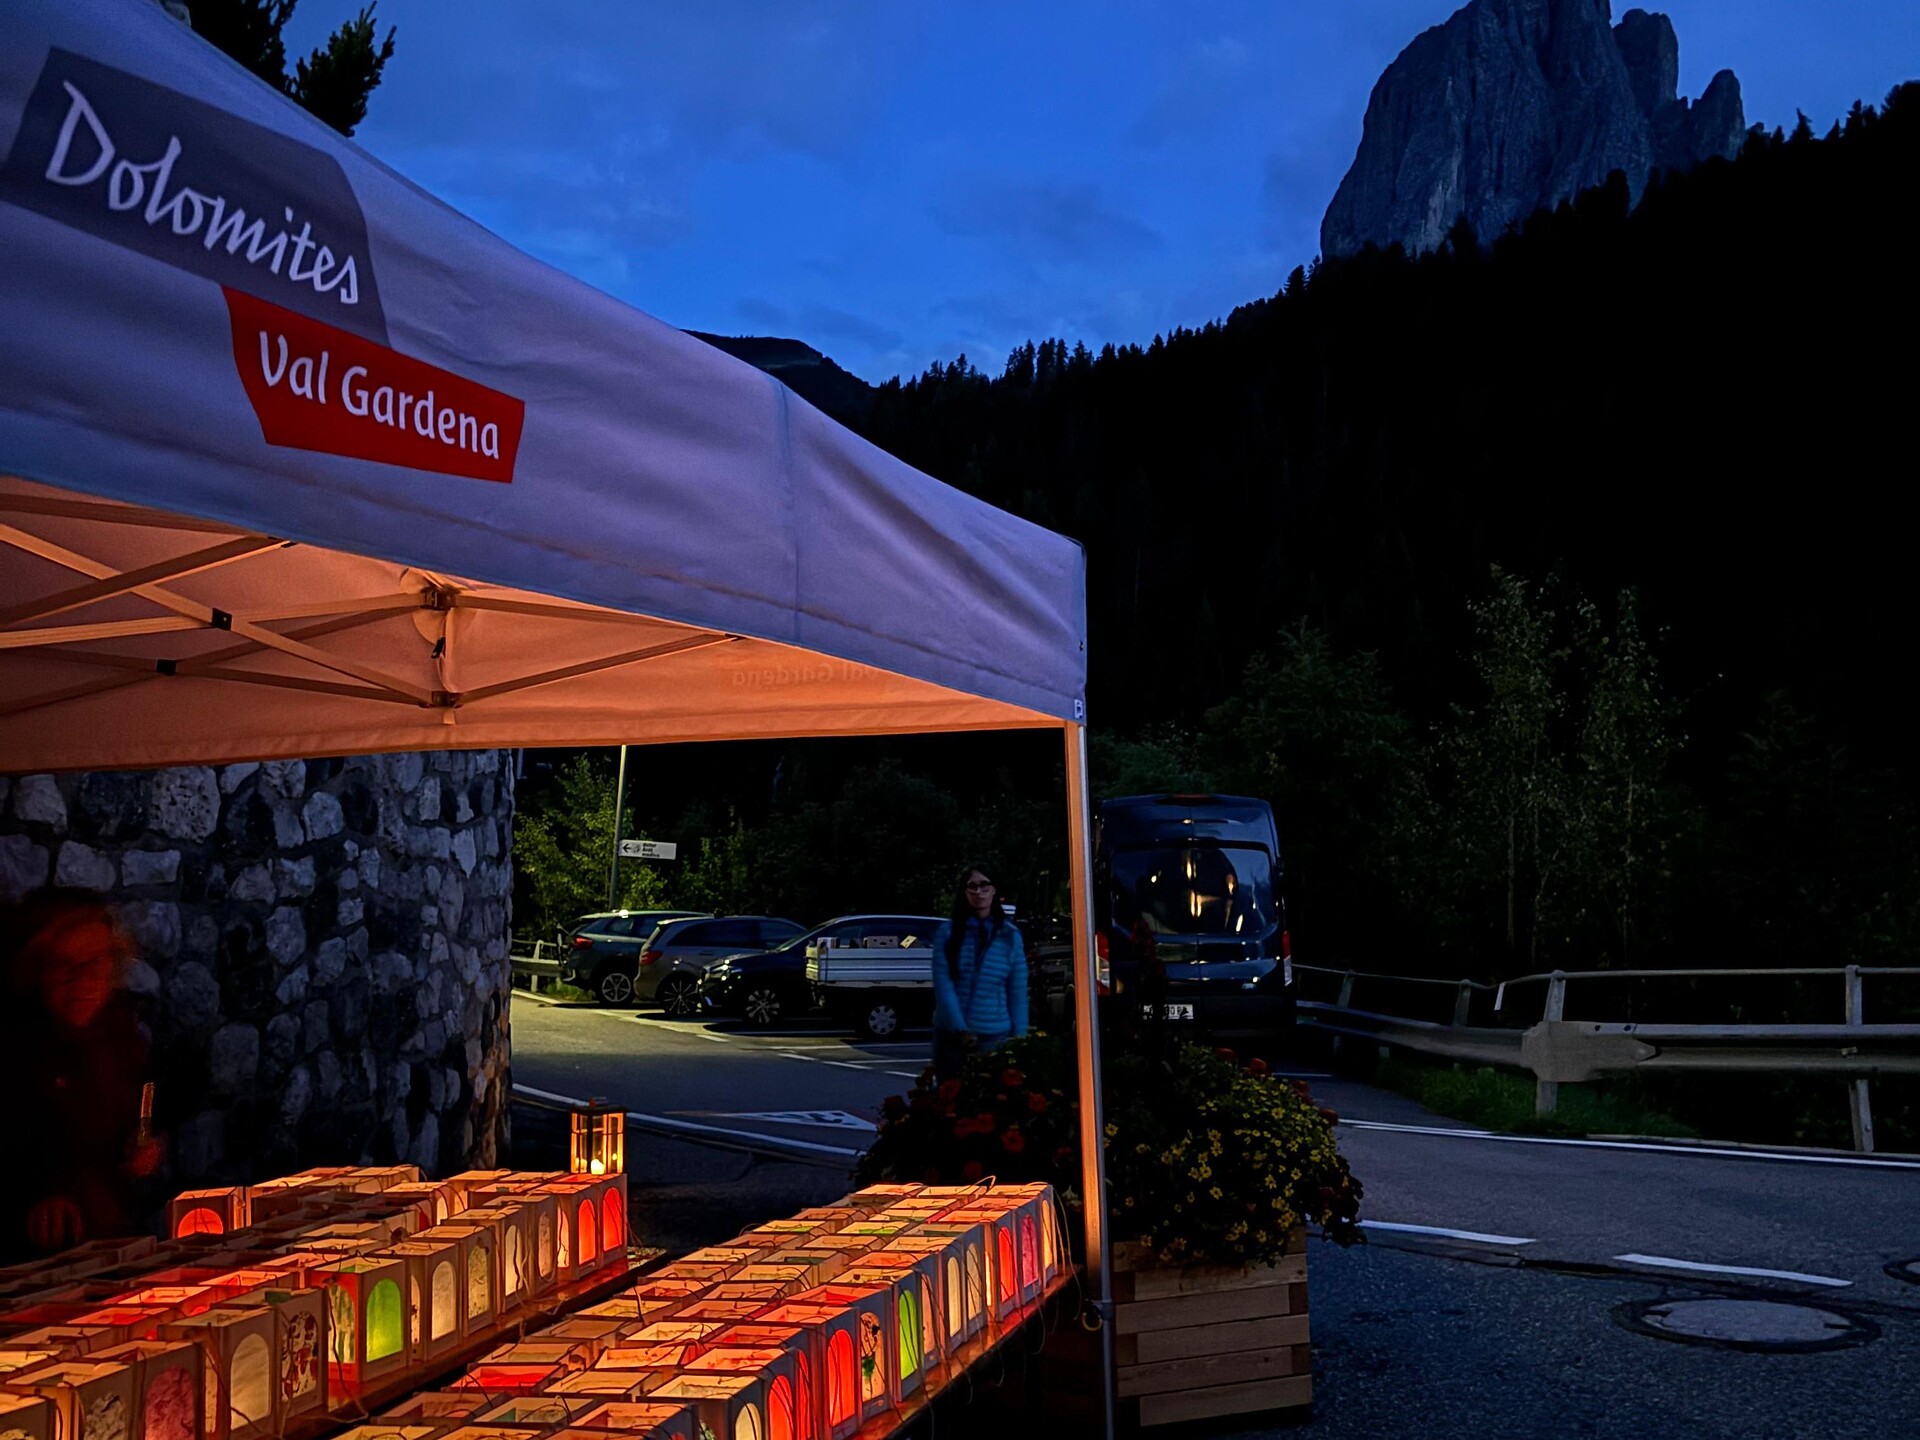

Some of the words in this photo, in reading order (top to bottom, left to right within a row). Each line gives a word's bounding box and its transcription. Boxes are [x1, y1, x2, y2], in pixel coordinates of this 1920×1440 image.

[46, 81, 358, 304] Dolomites
[260, 332, 329, 403] Val
[342, 366, 499, 459] Gardena
